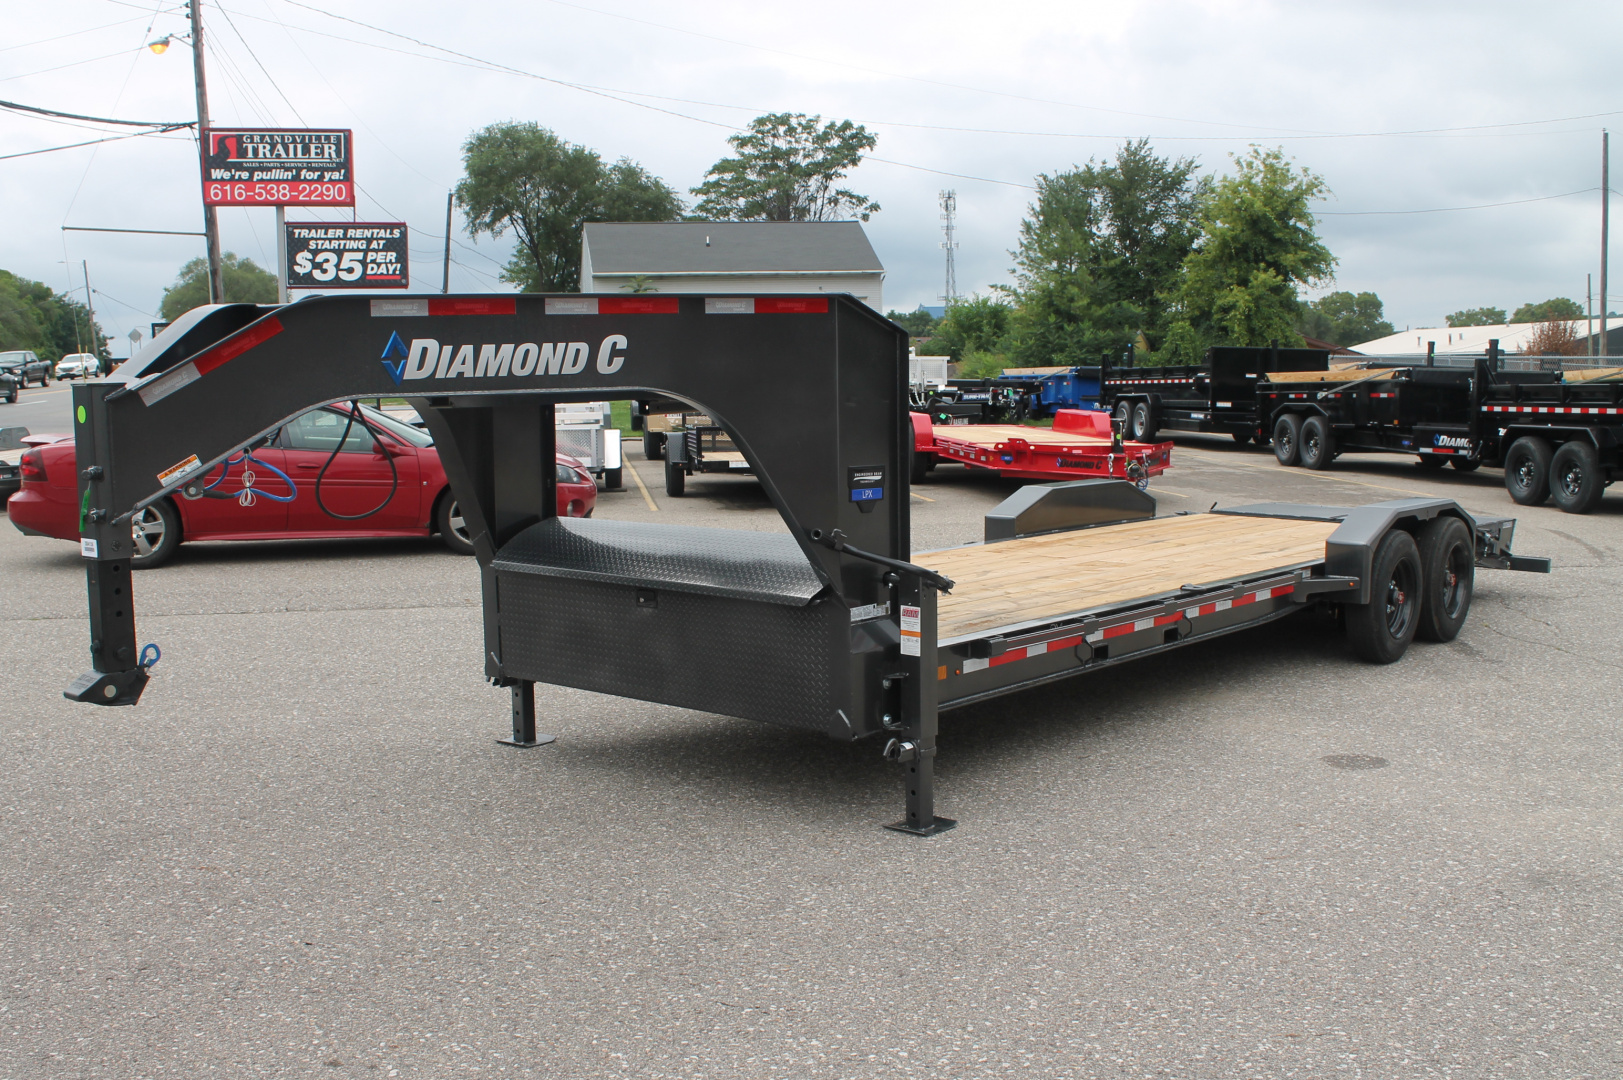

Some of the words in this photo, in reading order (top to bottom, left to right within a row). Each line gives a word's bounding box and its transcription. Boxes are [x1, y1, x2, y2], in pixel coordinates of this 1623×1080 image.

[242, 134, 338, 143] GRANDVILLE
[242, 143, 338, 158] TRAILER
[210, 168, 249, 180] We're
[253, 168, 296, 182] pullin'
[300, 169, 321, 180] for
[323, 169, 345, 182] ya!
[210, 184, 346, 200] 616-538-2290
[293, 228, 344, 238] TRAILER
[347, 229, 400, 238] RENTALS
[309, 240, 367, 249] STARTING
[370, 240, 386, 249] AT
[366, 252, 397, 263] PER
[293, 249, 364, 282] $35
[366, 264, 401, 274] DAY!
[402, 338, 590, 380] DIAMOND
[596, 334, 628, 374] C
[1060, 458, 1094, 469] DIAMOND
[1096, 460, 1102, 470] C
[862, 490, 873, 498] LPX
